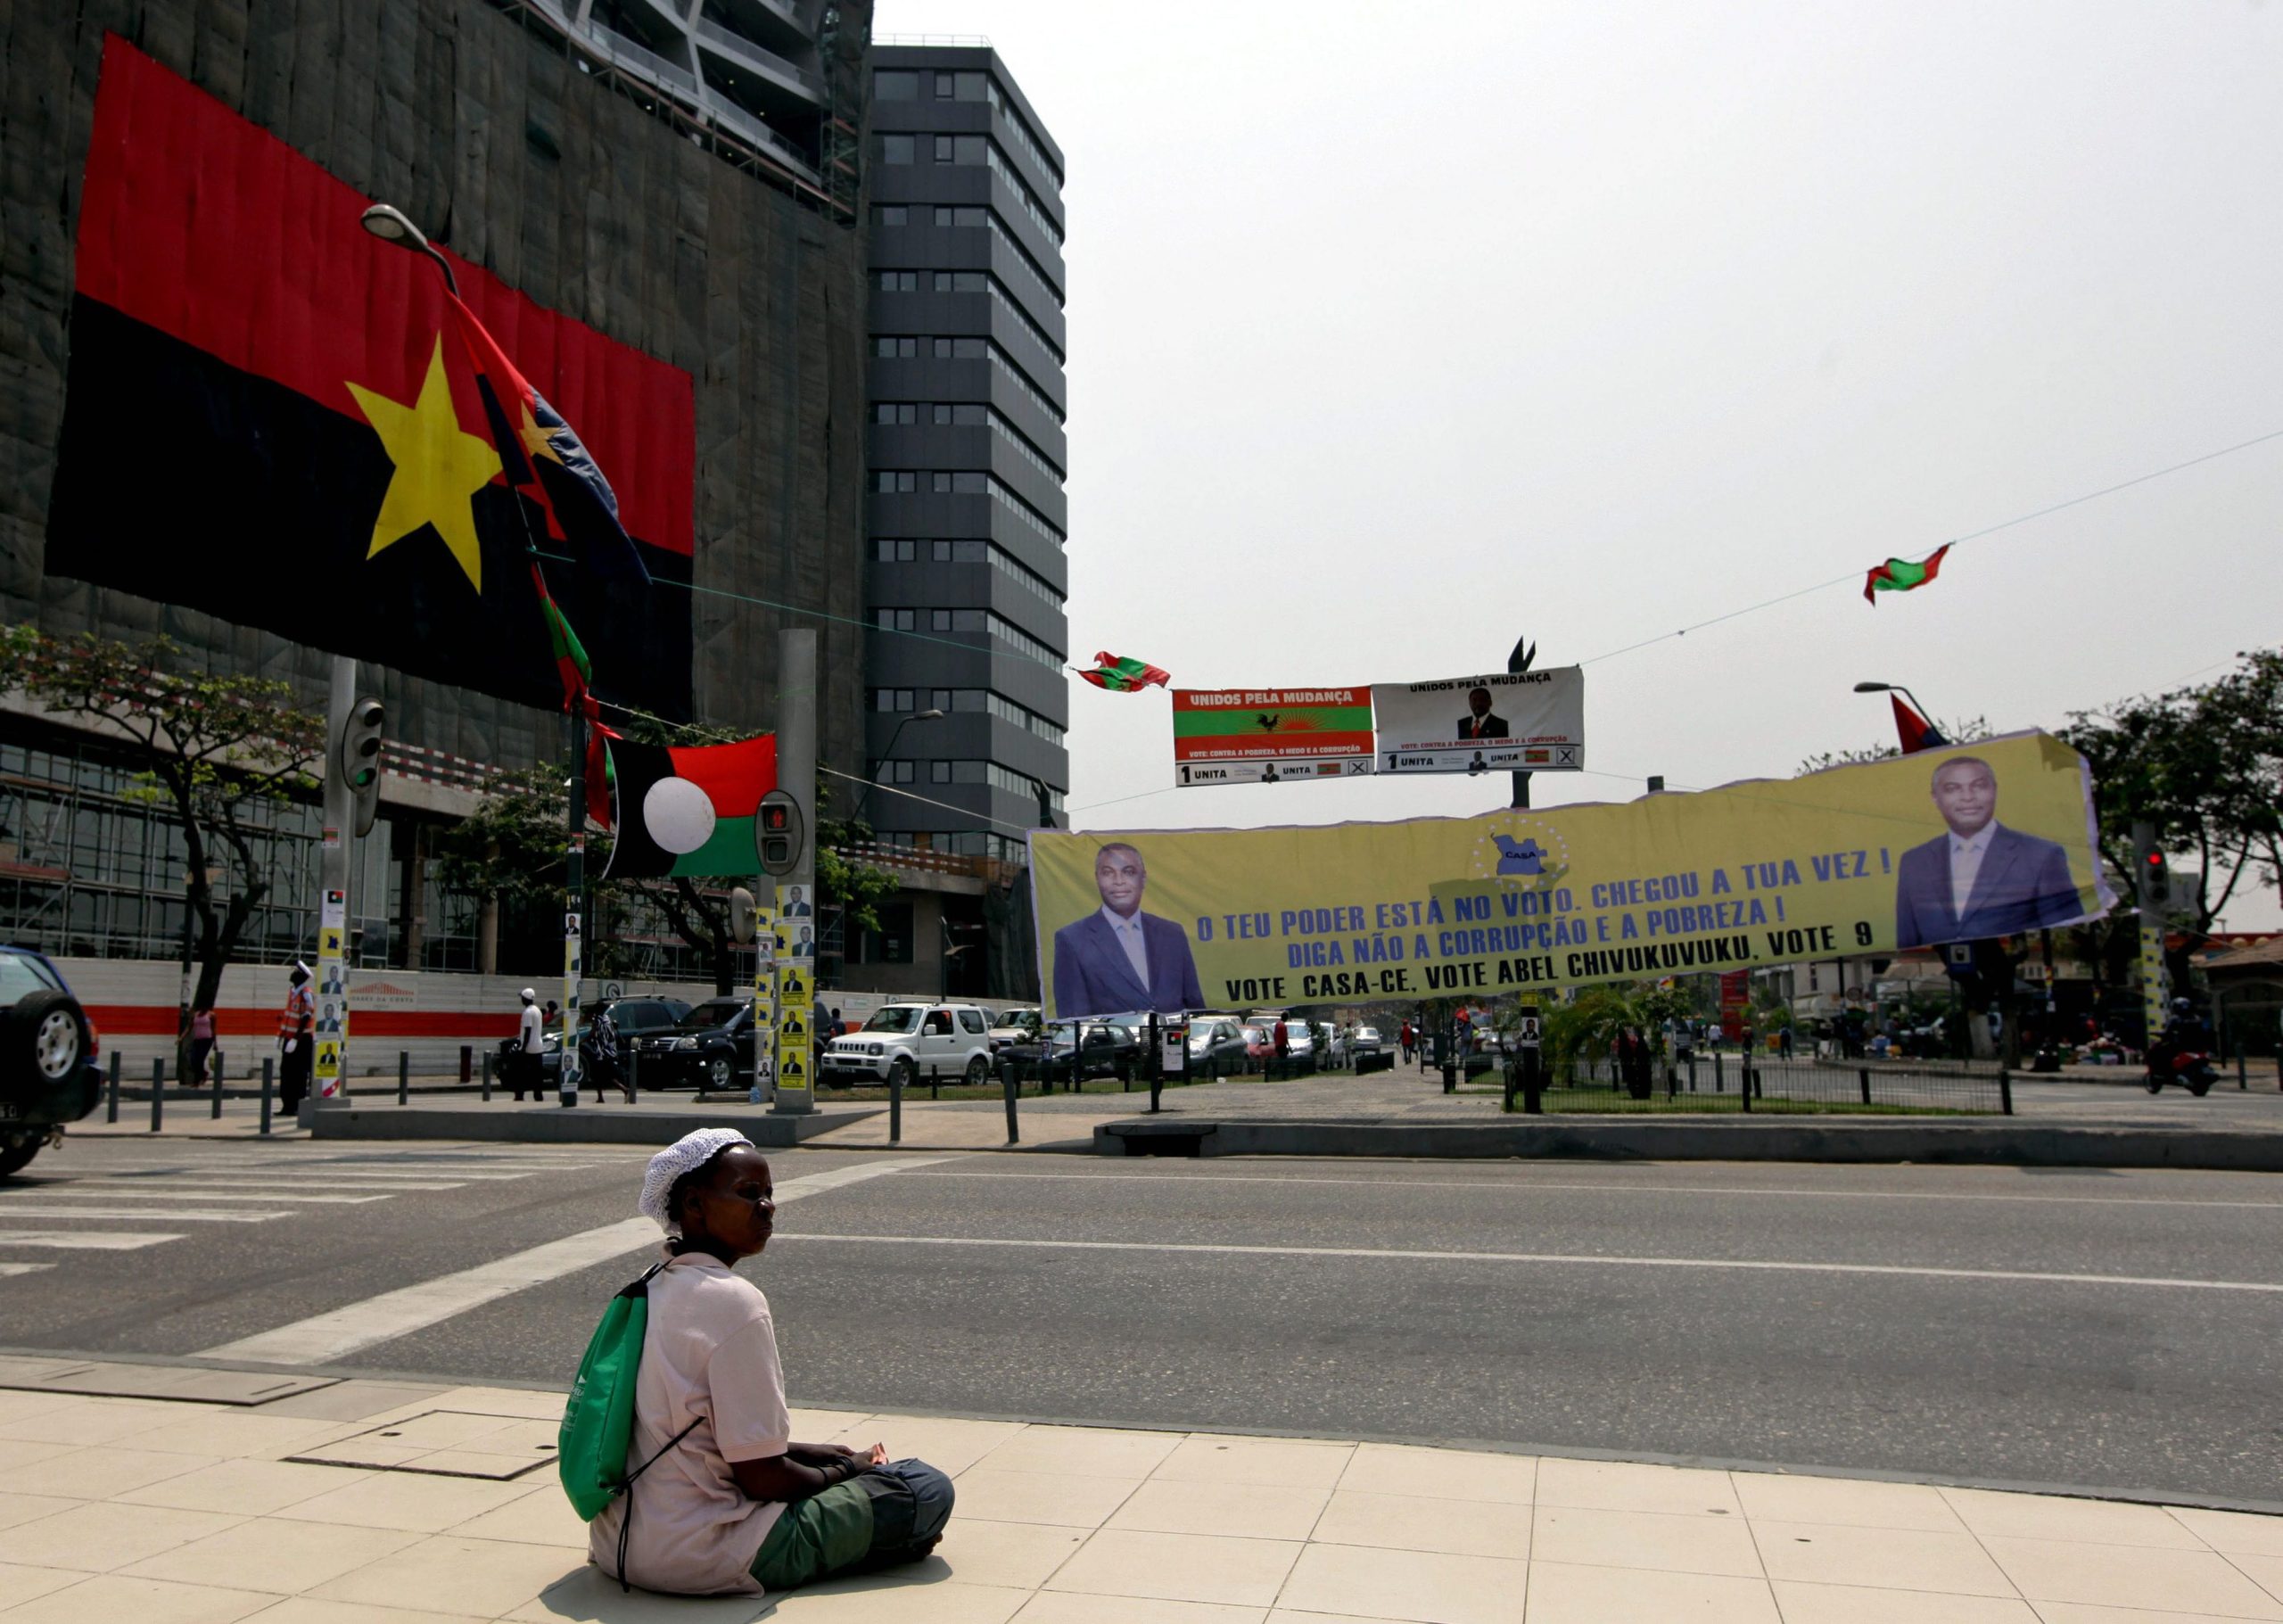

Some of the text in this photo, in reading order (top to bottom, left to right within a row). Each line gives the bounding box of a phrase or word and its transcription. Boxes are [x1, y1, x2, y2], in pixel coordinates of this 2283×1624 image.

[1410, 672, 1552, 692] UNIDOS PELA MUDANÇA
[1190, 691, 1353, 705] UNIDOS PELA MUDANÇA
[1209, 749, 1236, 757] CONTRA
[1389, 754, 1397, 769] 1
[1401, 757, 1433, 766] UNITA
[1491, 754, 1518, 762] UNITA
[1182, 766, 1191, 783] 1
[1195, 770, 1227, 779] UNITA
[1283, 767, 1311, 775] UNITA
[1505, 851, 1537, 860] CASA
[1198, 916, 1213, 942] O
[1223, 912, 1271, 940] TEU
[1281, 906, 1365, 936] PODER
[1376, 896, 1445, 929] ESTÁ
[1455, 895, 1491, 922] NO
[1501, 887, 1582, 919] VOTO.
[1591, 872, 1699, 909] CHEGOU
[1712, 868, 1731, 895] A
[1742, 859, 1801, 891] TUA
[1288, 940, 1345, 969] DIGA
[1353, 932, 1405, 964] NÃO
[1414, 934, 1430, 960] A
[1439, 916, 1587, 957] CORRUPÇÃO
[1596, 916, 1611, 942] E
[1621, 912, 1639, 940] A
[1225, 921, 1874, 1002] VOTE CASA-CE, VOTE ABEL CHIVUKUVUKU, VOTE 9
